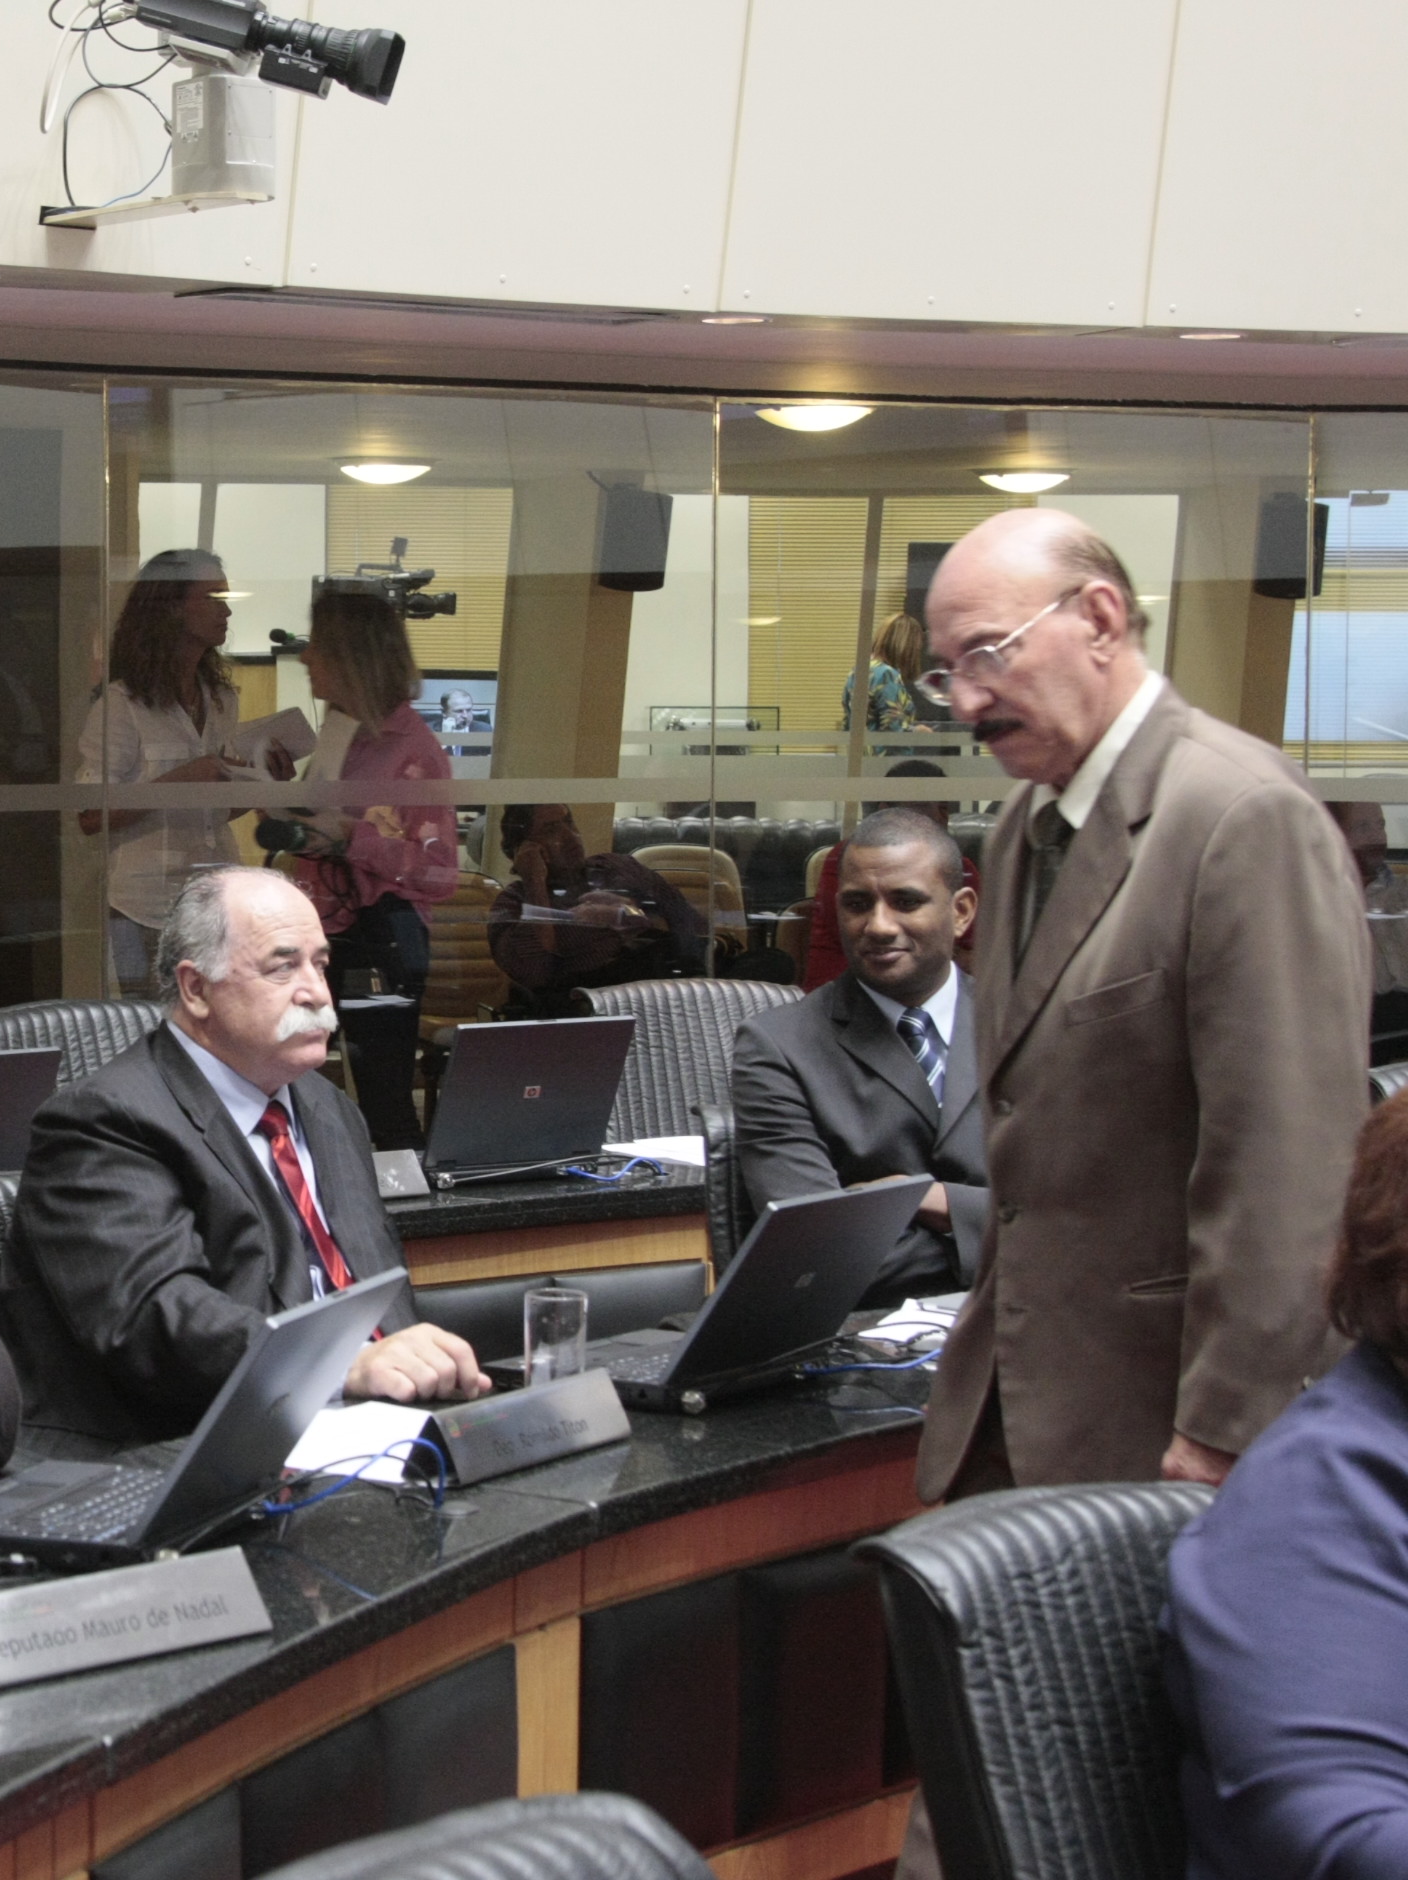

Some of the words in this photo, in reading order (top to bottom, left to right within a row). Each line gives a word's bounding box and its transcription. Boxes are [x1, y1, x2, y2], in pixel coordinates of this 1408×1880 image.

[82, 1614, 141, 1639] Mauro
[147, 1605, 170, 1628] de
[173, 1594, 229, 1621] Nadal
